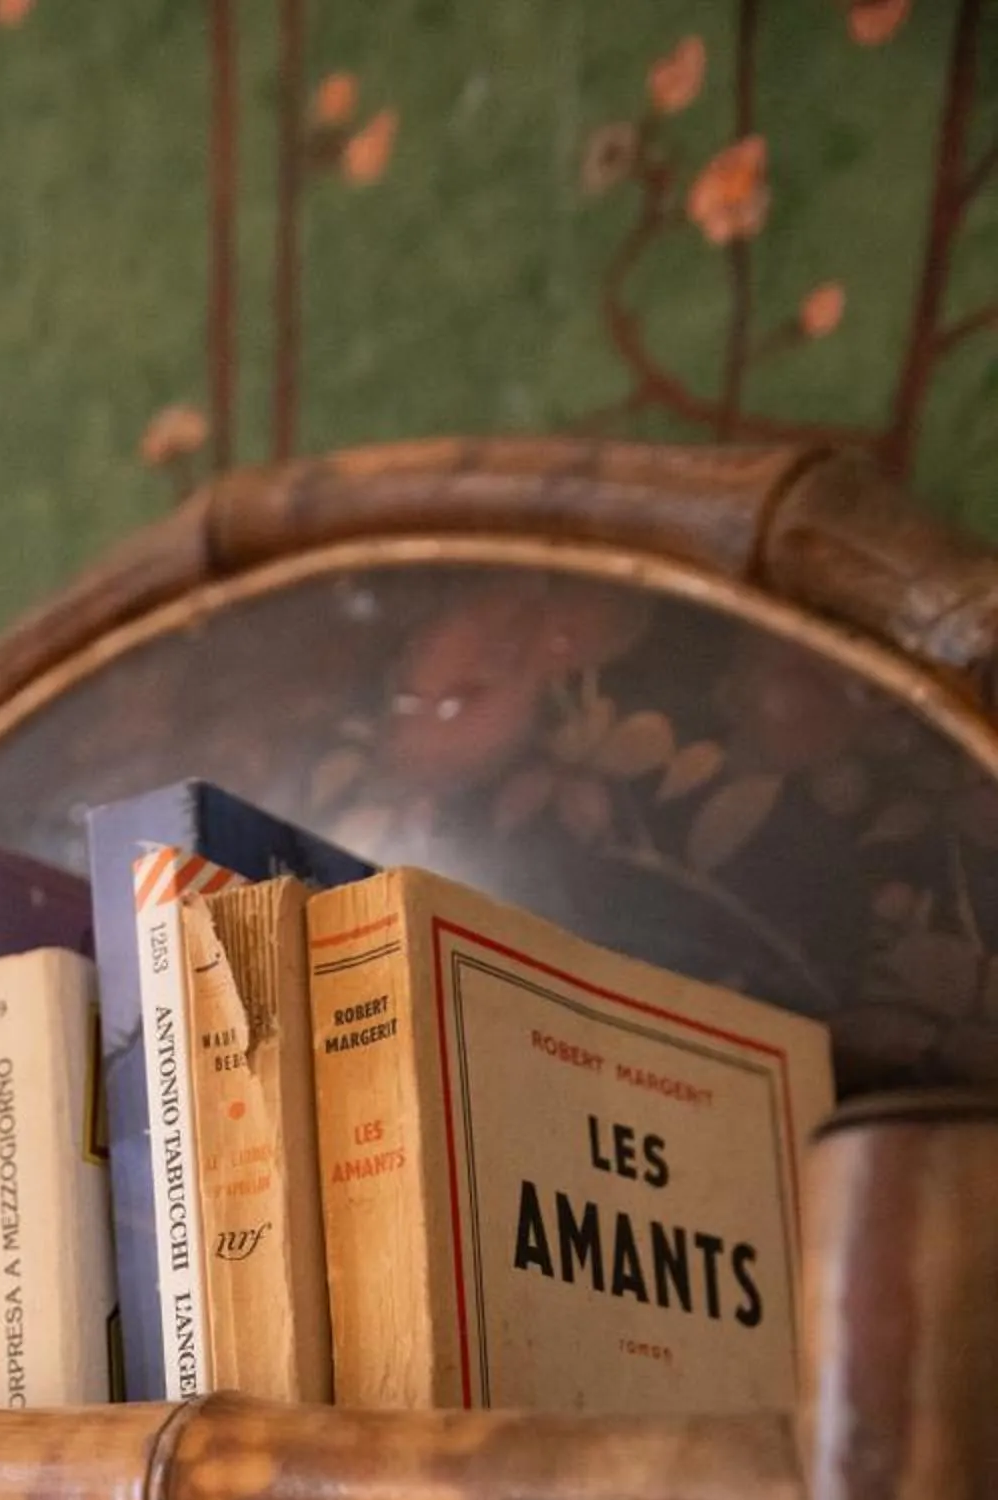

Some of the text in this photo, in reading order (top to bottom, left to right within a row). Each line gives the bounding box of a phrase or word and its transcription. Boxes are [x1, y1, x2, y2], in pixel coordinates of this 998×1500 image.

[333, 995, 389, 1027] ROBERT
[324, 1018, 398, 1054] MARGERIT
[531, 1029, 605, 1074] ROBERT
[155, 1005, 181, 1126] ANTONIO
[354, 1119, 384, 1146] LES
[587, 1113, 670, 1188] LES
[331, 1147, 407, 1185] AMANTS
[163, 1129, 190, 1272] TABUCCHI
[4, 1258, 22, 1278] A
[513, 1179, 764, 1328] AMANTS
